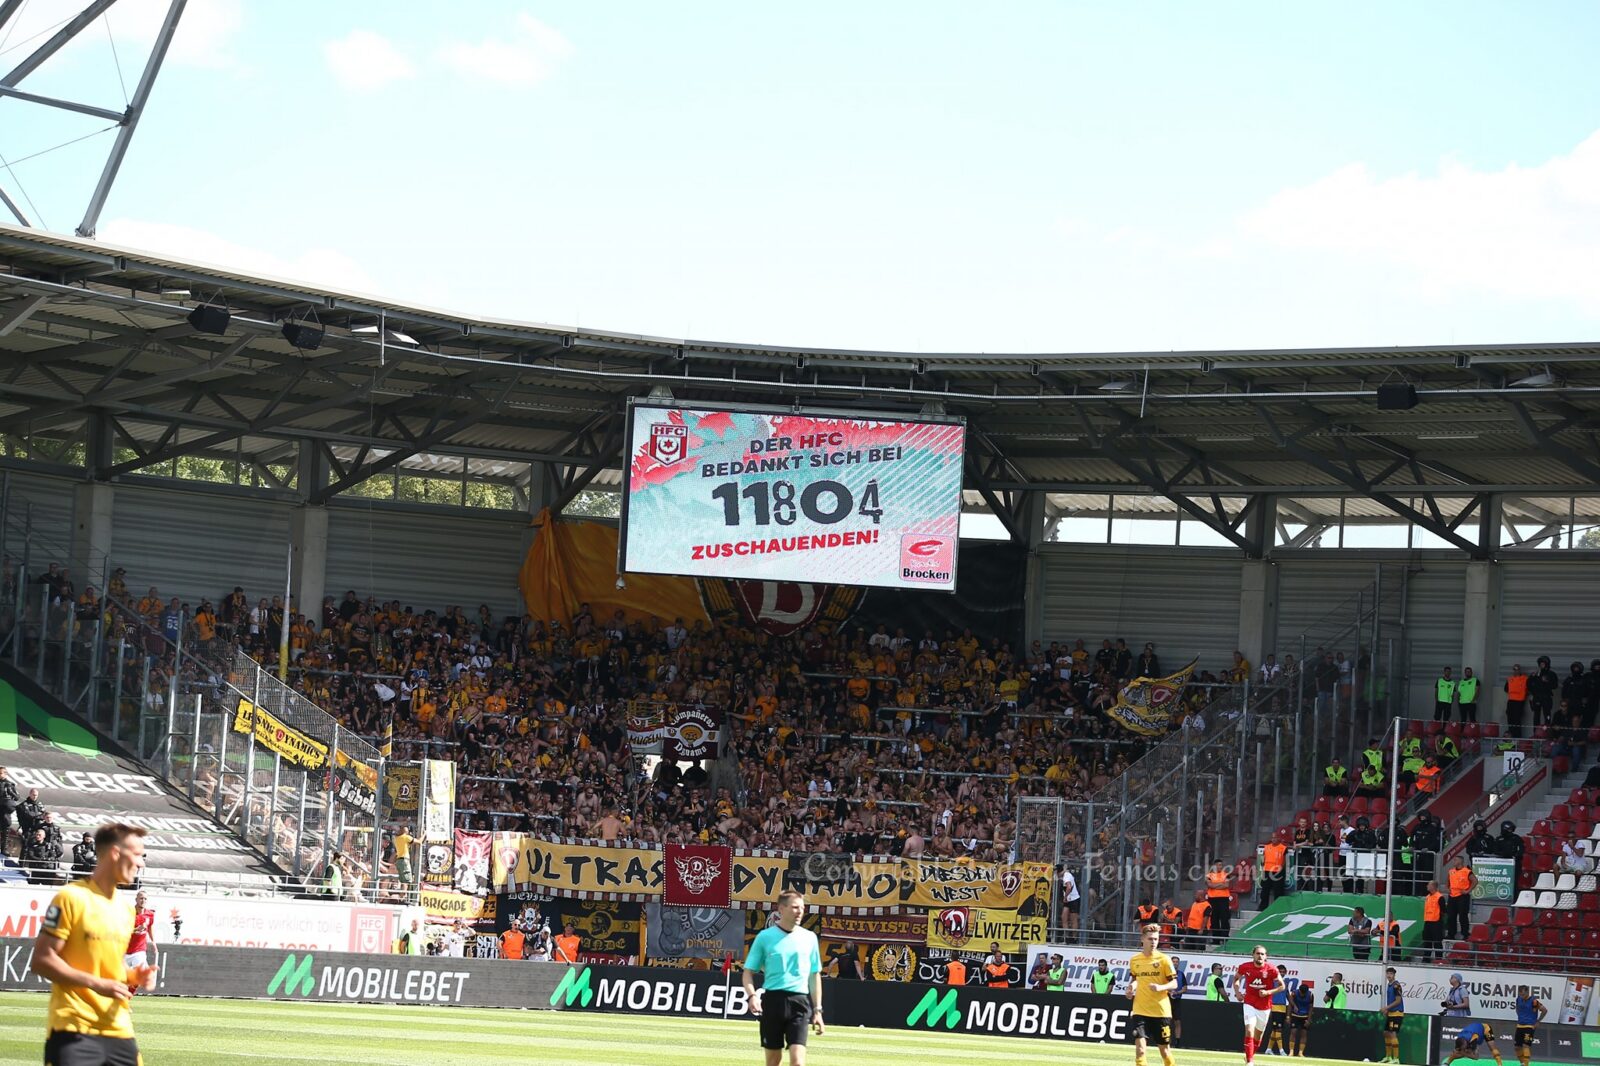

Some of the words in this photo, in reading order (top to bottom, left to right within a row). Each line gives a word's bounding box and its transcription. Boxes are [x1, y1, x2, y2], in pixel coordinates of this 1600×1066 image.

[654, 426, 685, 436] HFC
[750, 436, 793, 454] DER
[799, 431, 843, 450] HFC
[702, 455, 804, 478] BEDANKT
[809, 449, 861, 468] SICH
[868, 446, 902, 463] BEI
[712, 478, 883, 526] 11804
[691, 529, 879, 560] ZUSCHAUENDEN!
[902, 567, 950, 580] Brocken
[242, 710, 276, 735] LESNIG
[1506, 756, 1521, 771] 10
[526, 848, 664, 888] ULTRAS
[919, 864, 998, 883] DRESDEN
[1478, 867, 1502, 875] Wasser
[423, 896, 467, 912] BRIGADE
[931, 886, 987, 903] WEST
[207, 910, 263, 929] hunderte
[361, 919, 383, 928] HFC
[318, 966, 471, 1002] MOBILEBET
